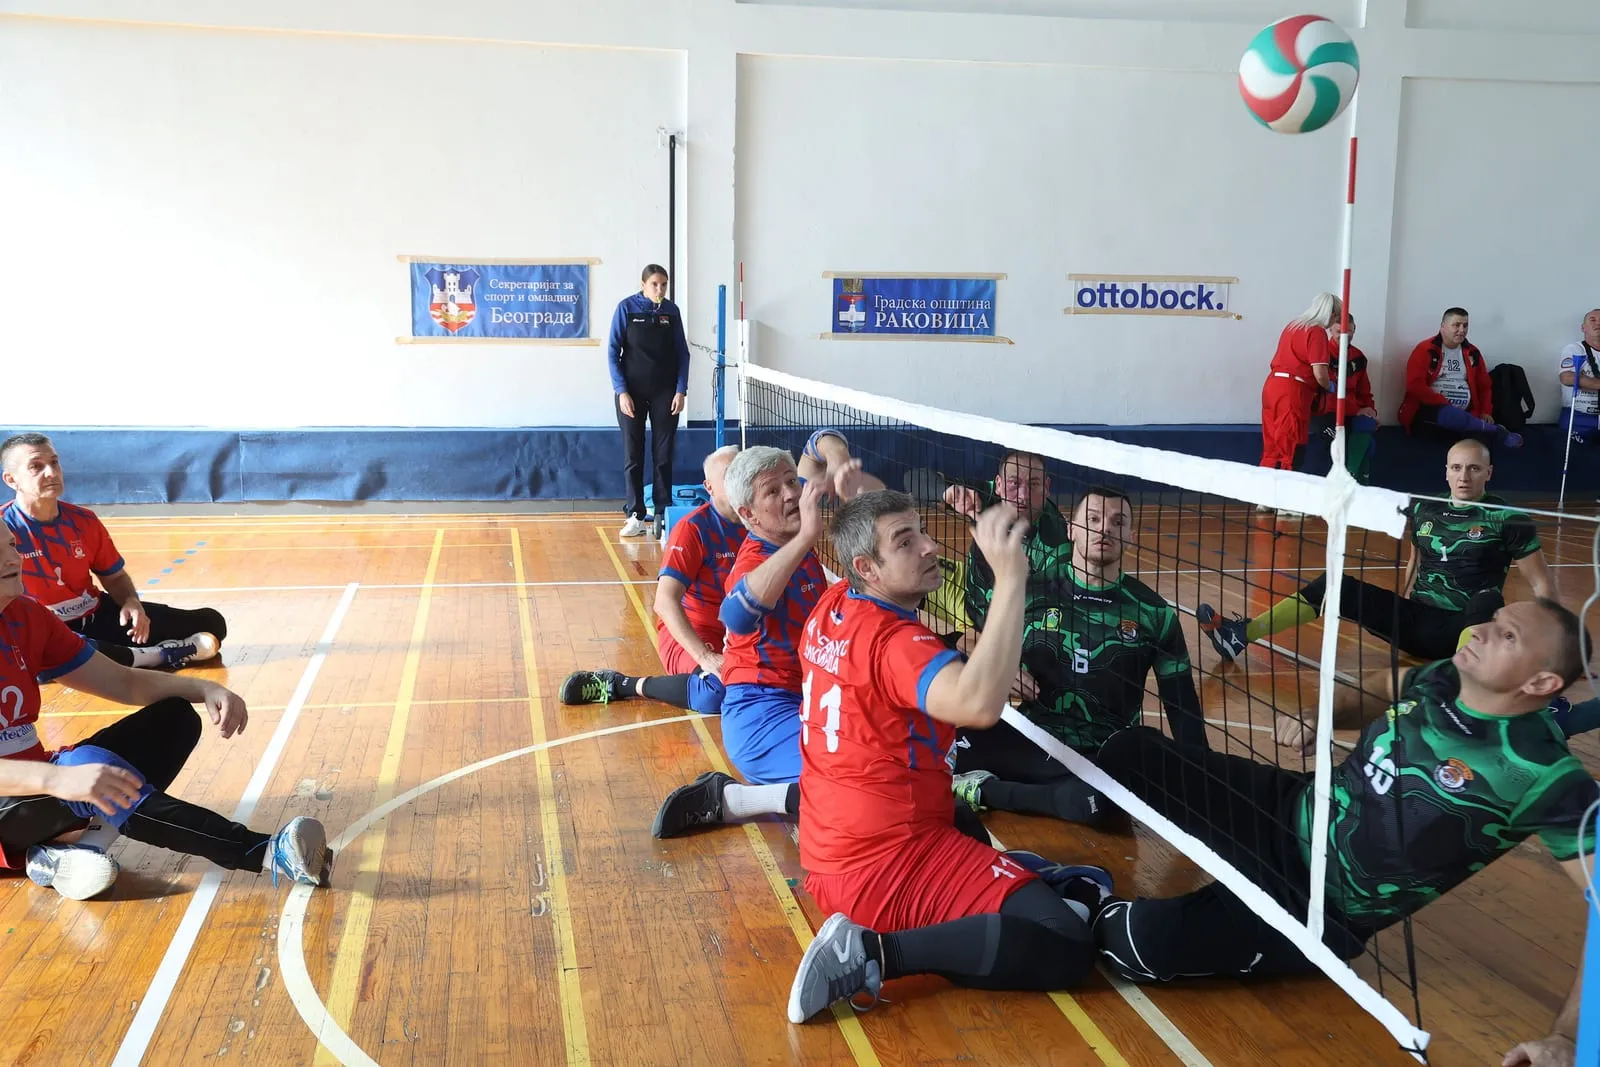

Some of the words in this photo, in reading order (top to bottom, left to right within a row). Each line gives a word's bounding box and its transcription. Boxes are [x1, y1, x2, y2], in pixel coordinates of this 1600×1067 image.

[489, 279, 561, 291] Секретаријат
[562, 282, 574, 290] за
[484, 294, 515, 303] спорт
[518, 294, 525, 302] и
[528, 294, 580, 305] омладину
[874, 295, 927, 311] Градска
[930, 298, 992, 310] општина
[1077, 283, 1224, 310] ottobock.
[491, 307, 575, 328] Београда
[874, 312, 990, 331] РАКОВИЦА
[1447, 359, 1461, 372] 12
[1439, 546, 1448, 562] 1
[54, 566, 65, 586] 1
[799, 669, 842, 753] 11
[991, 855, 1025, 879] 11
